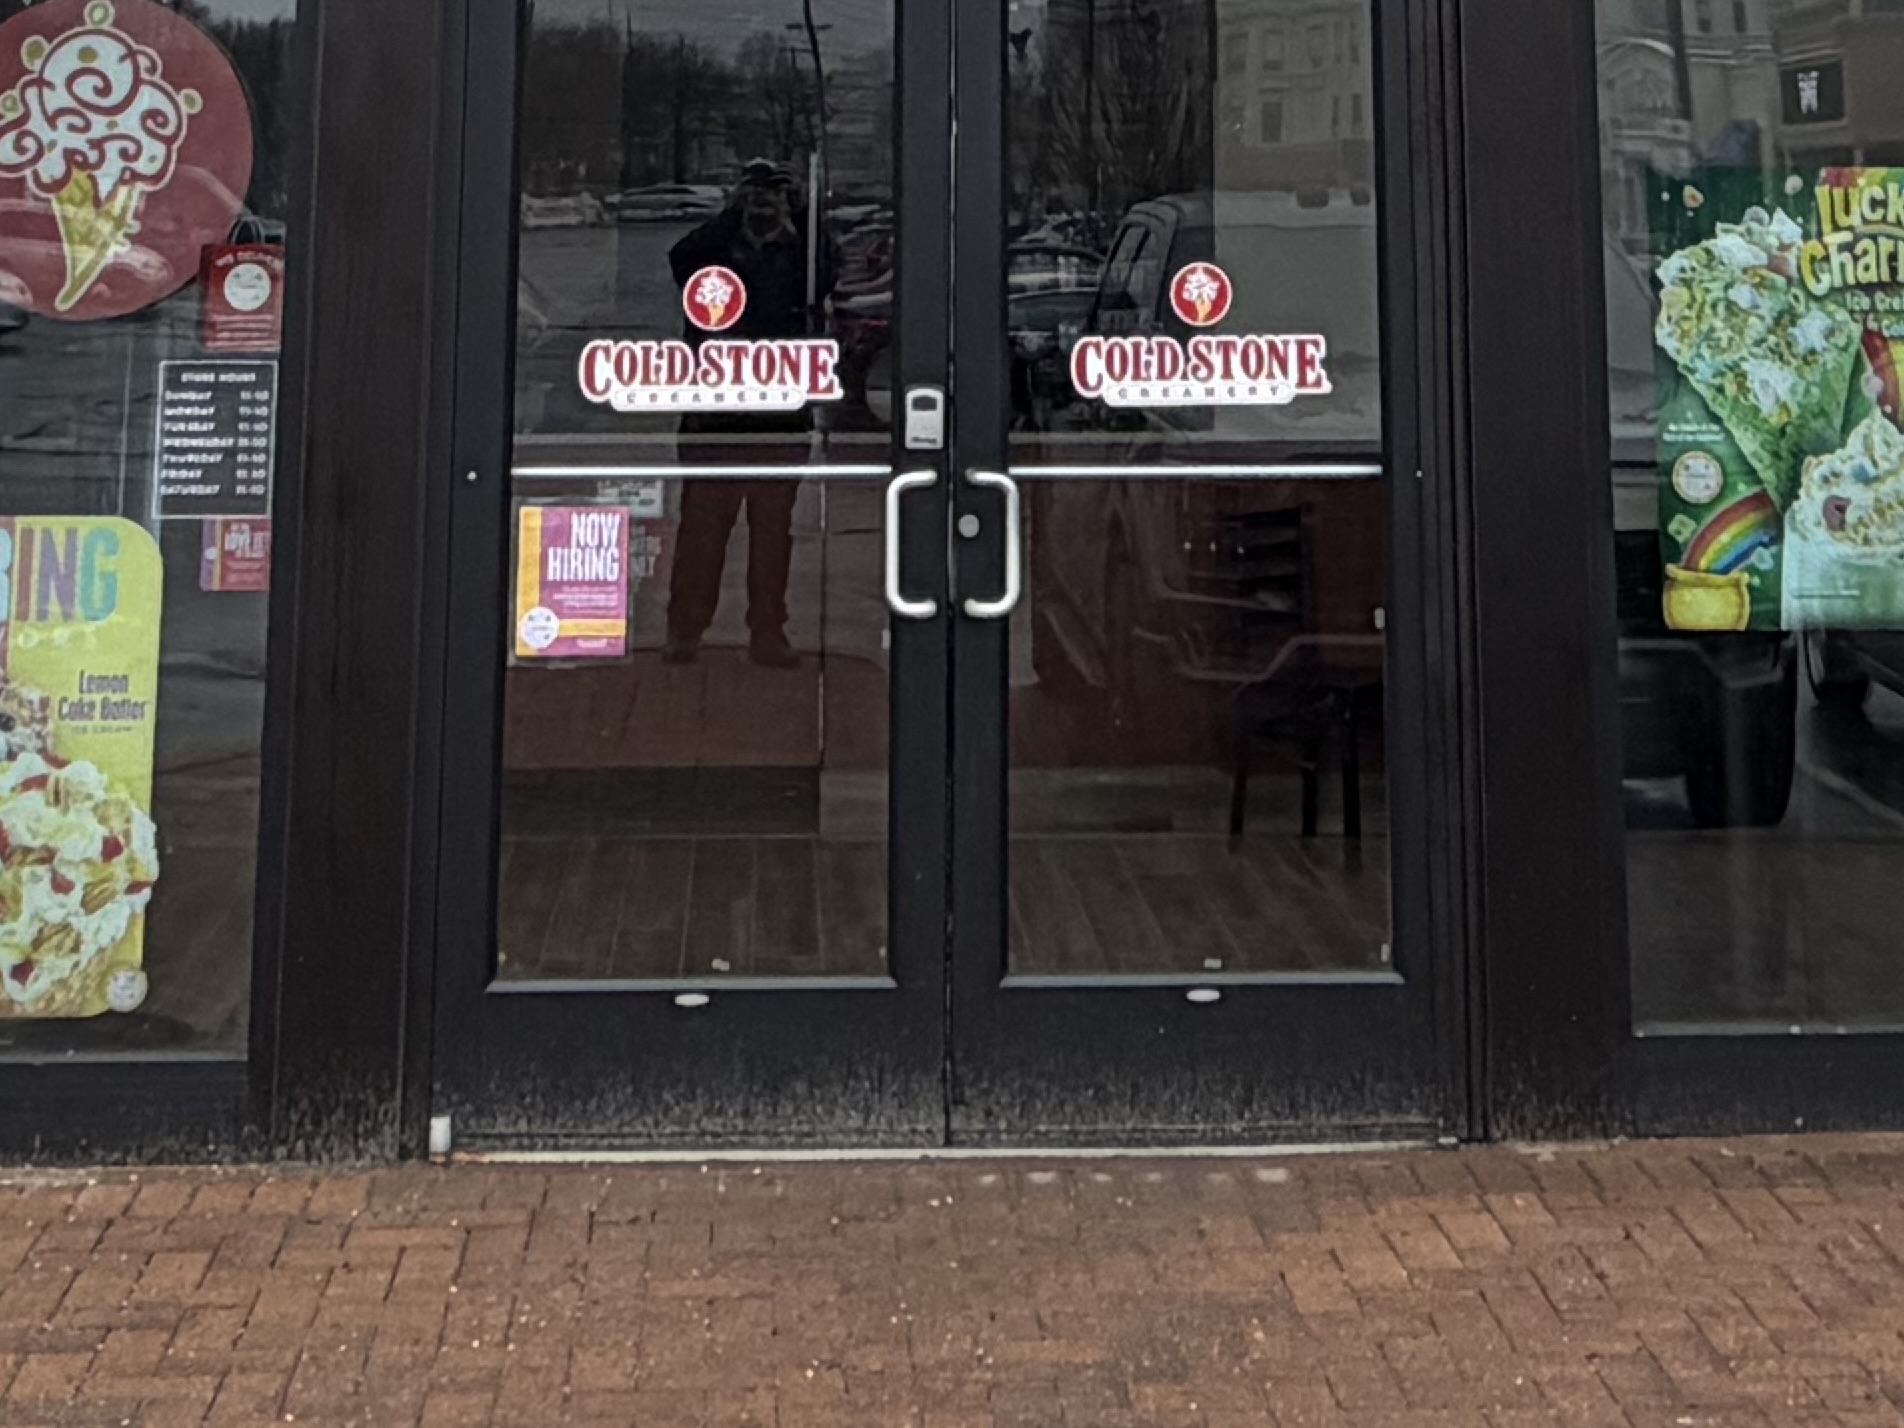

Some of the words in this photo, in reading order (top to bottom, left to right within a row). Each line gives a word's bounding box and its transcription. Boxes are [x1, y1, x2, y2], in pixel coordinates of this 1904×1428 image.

[584, 343, 692, 397] COLD
[699, 343, 835, 395] STONE
[1074, 340, 1182, 393] COLD
[1189, 338, 1324, 389] STONE
[570, 512, 621, 547] NOW
[546, 546, 620, 582] HIRING
[78, 668, 129, 694] Lemon
[57, 695, 96, 721] Cake
